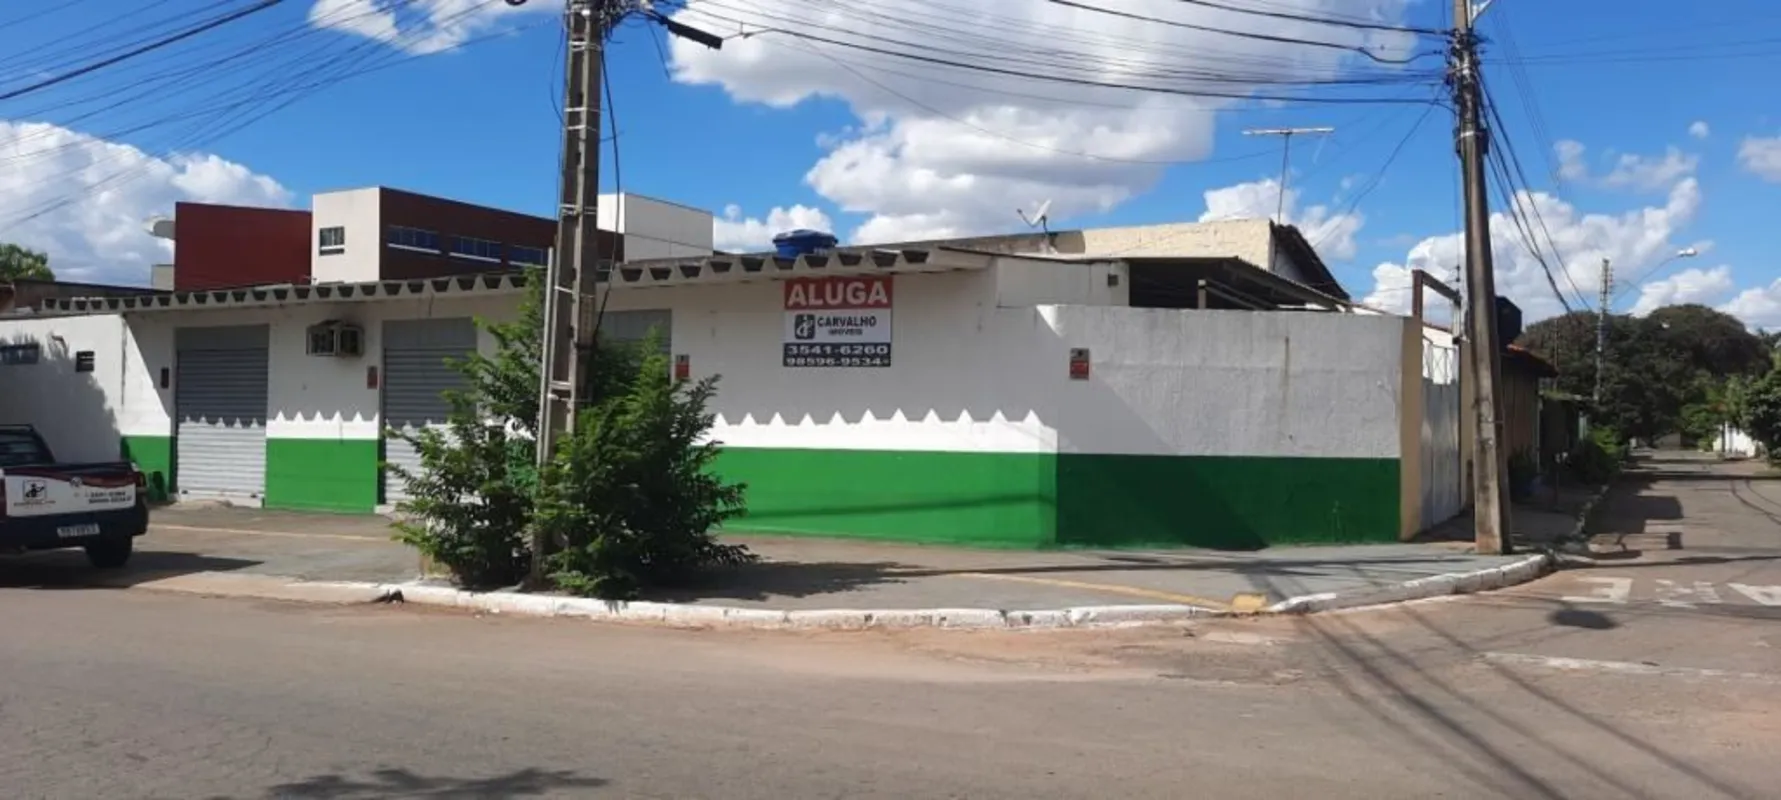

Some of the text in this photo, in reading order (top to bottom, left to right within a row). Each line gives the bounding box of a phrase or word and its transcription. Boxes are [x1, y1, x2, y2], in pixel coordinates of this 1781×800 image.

[787, 281, 888, 307] ALUGA
[817, 316, 877, 327] CARVALHO
[787, 345, 888, 355] 3541-6260
